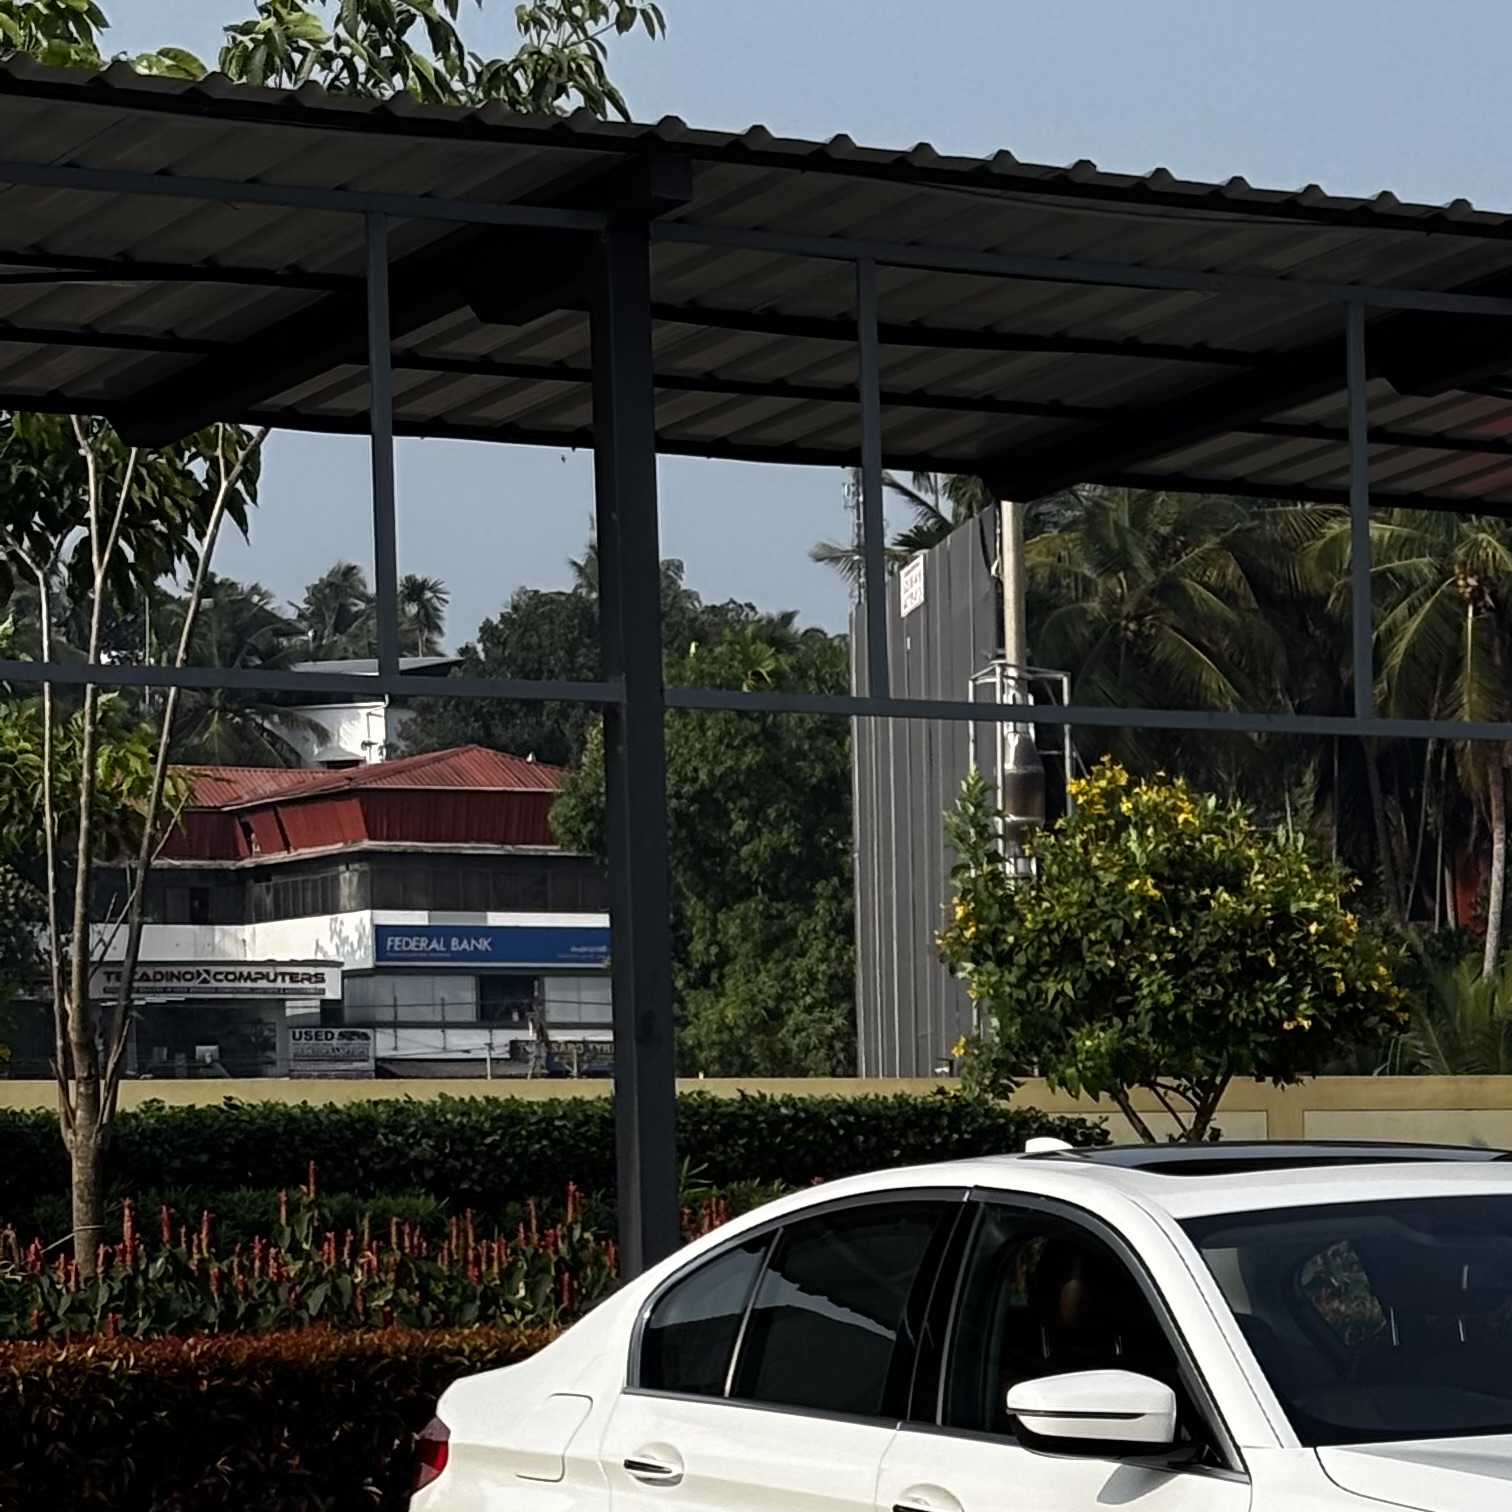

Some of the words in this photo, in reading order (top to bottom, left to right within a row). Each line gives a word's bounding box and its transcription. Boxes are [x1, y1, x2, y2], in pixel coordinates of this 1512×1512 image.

[386, 936, 446, 951] FEDERAL
[451, 937, 492, 952] BANK
[212, 971, 326, 984] COMPUTERS
[292, 1030, 335, 1041] USED
